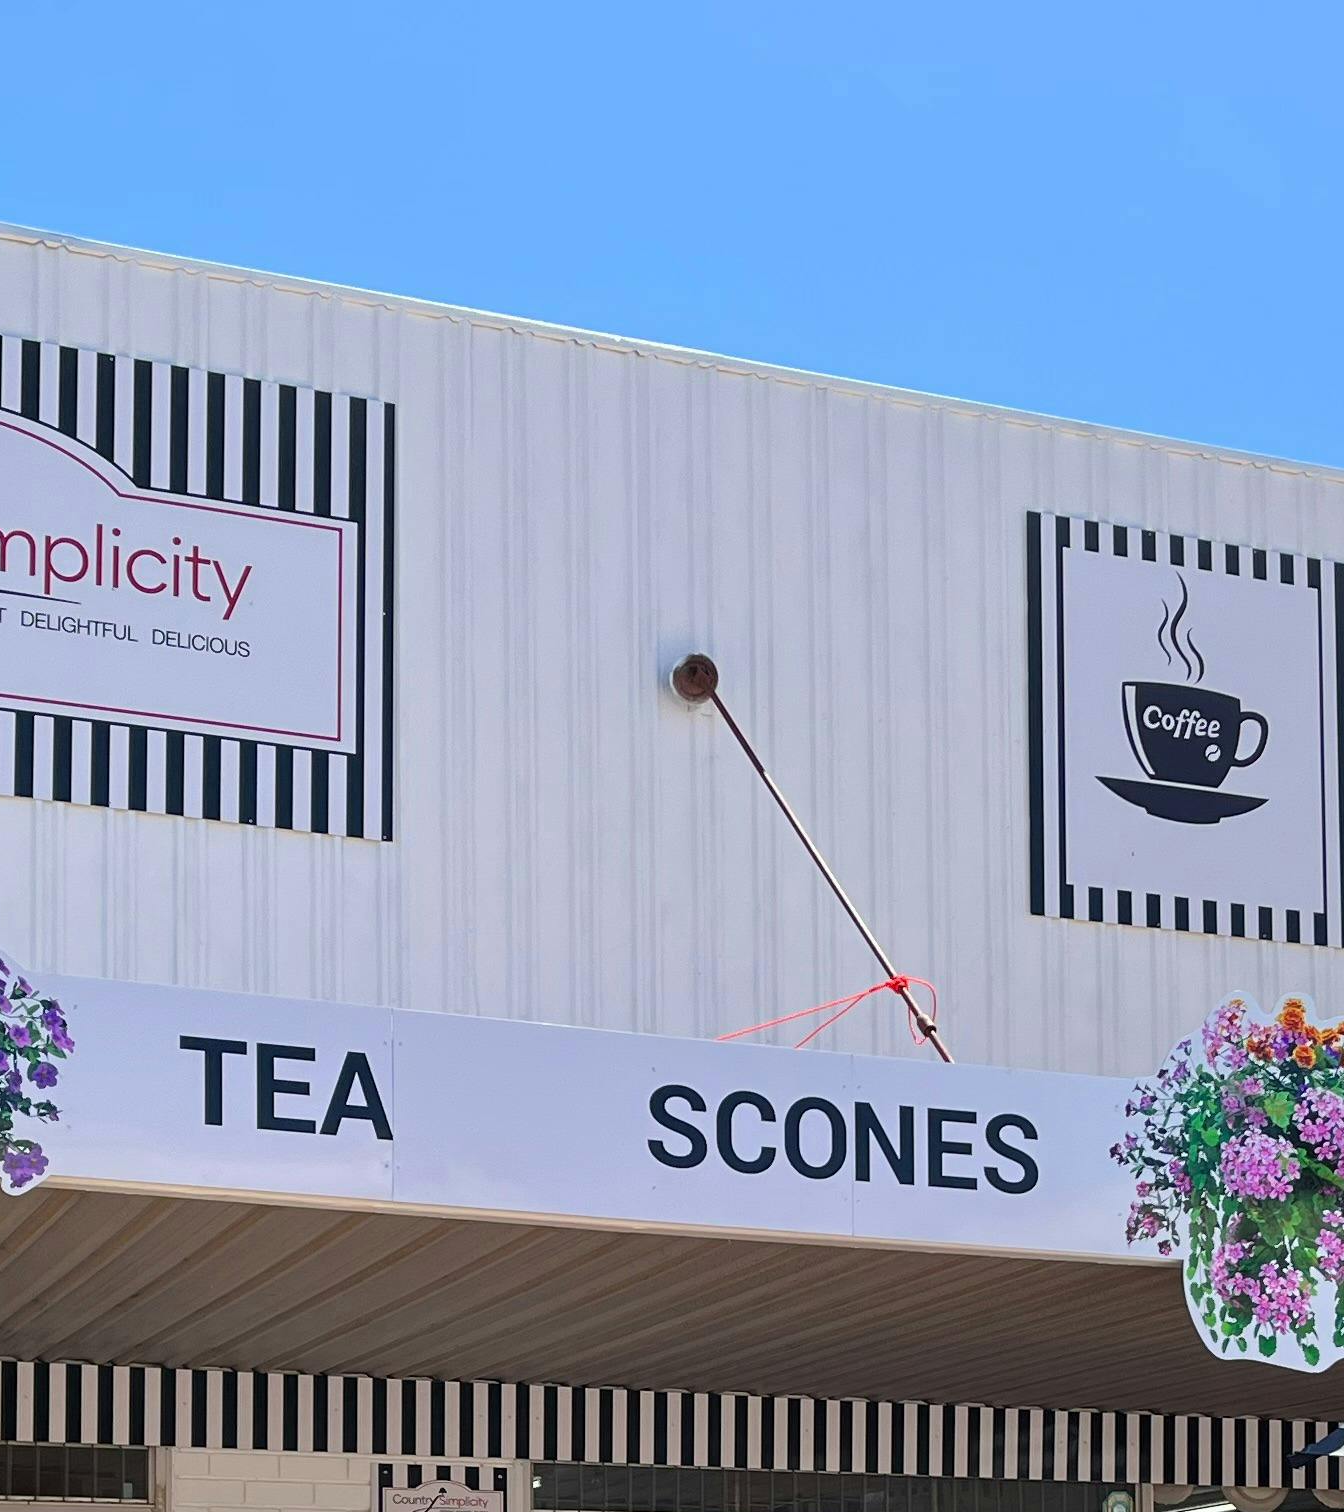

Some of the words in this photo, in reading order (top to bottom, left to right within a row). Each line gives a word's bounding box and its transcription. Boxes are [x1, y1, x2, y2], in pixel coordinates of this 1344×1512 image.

[20, 609, 140, 644] DELIGHTFUL
[151, 627, 251, 659] DELICIOUS
[1141, 704, 1221, 740] Coffee
[179, 1035, 394, 1140] TEA
[647, 1084, 1039, 1194] SCONES
[440, 1495, 489, 1509] Simplicity
